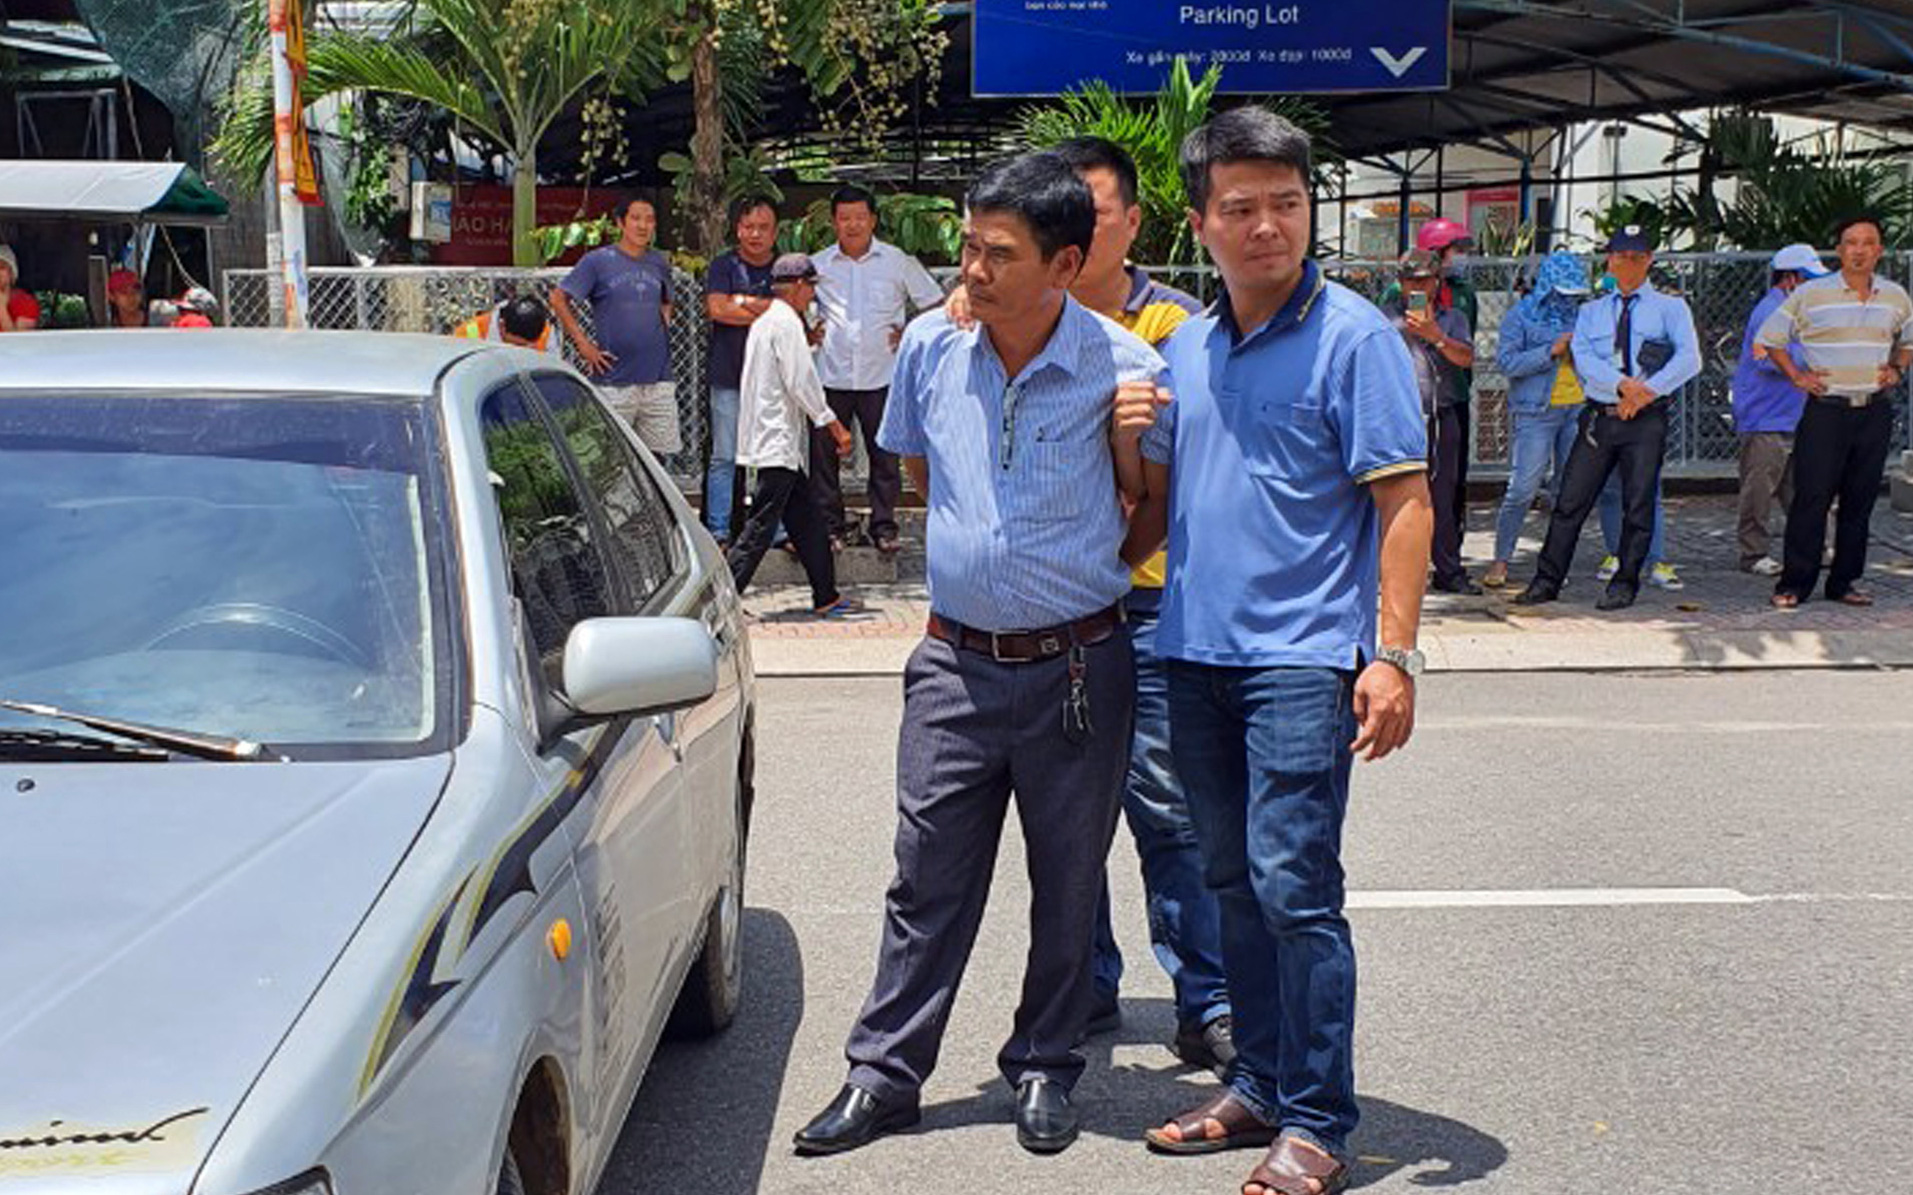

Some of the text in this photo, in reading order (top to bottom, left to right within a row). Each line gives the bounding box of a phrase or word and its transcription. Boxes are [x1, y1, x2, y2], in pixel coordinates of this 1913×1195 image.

[1180, 4, 1299, 29] Parking Lot
[1126, 50, 1144, 63] Xe
[1258, 50, 1275, 62] Xe
